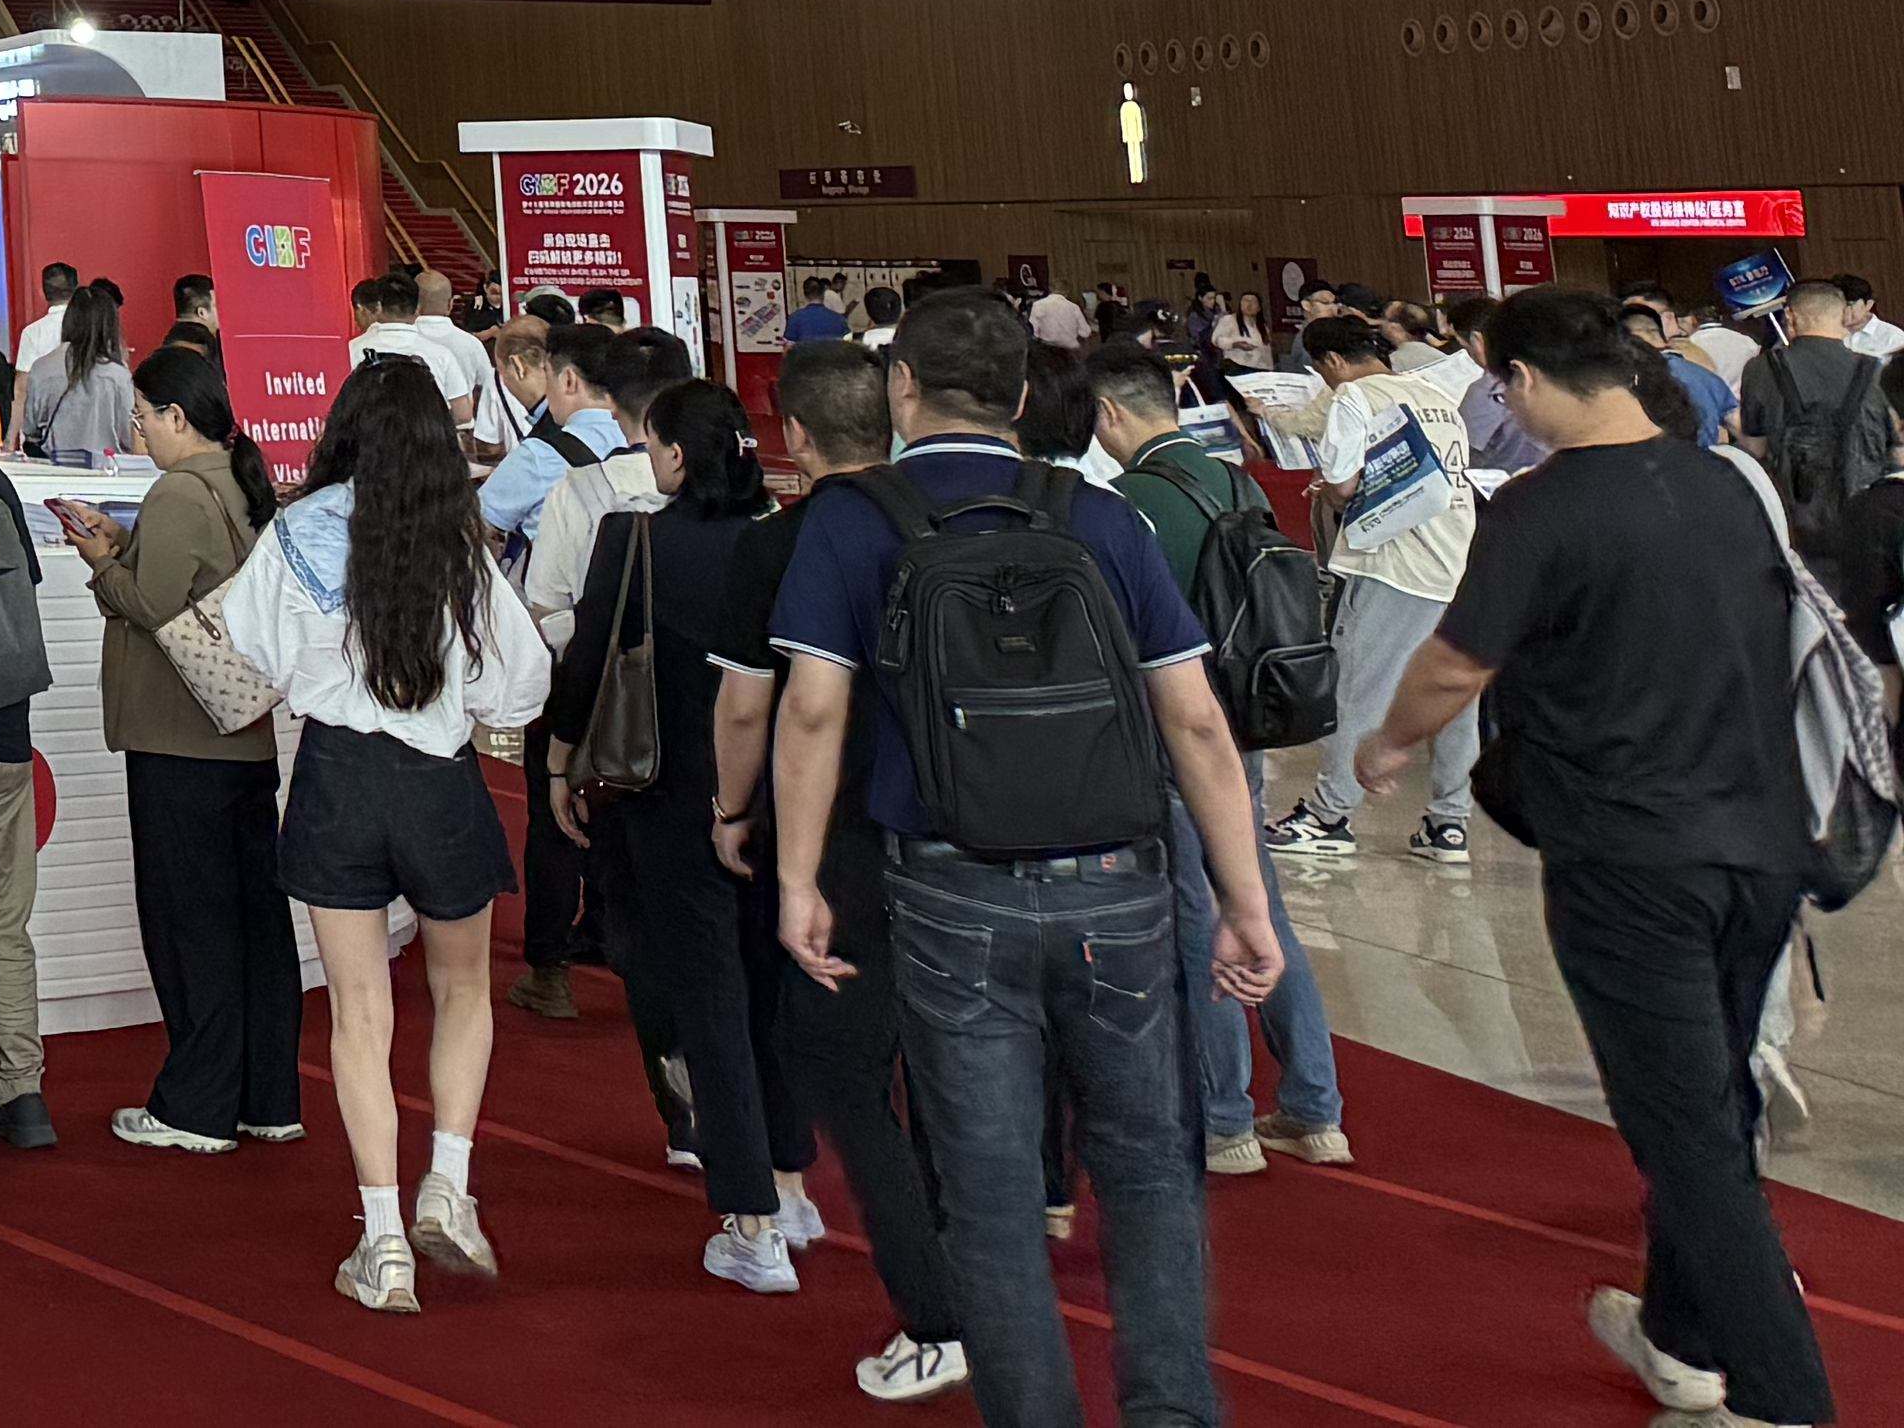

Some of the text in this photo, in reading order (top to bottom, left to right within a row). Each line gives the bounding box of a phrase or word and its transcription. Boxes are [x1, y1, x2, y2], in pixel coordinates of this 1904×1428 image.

[520, 173, 623, 196] CIBF 2026
[245, 224, 311, 269] CIBF
[265, 371, 326, 396] Invited
[243, 416, 320, 443] Internati
[274, 463, 307, 484] Visi
